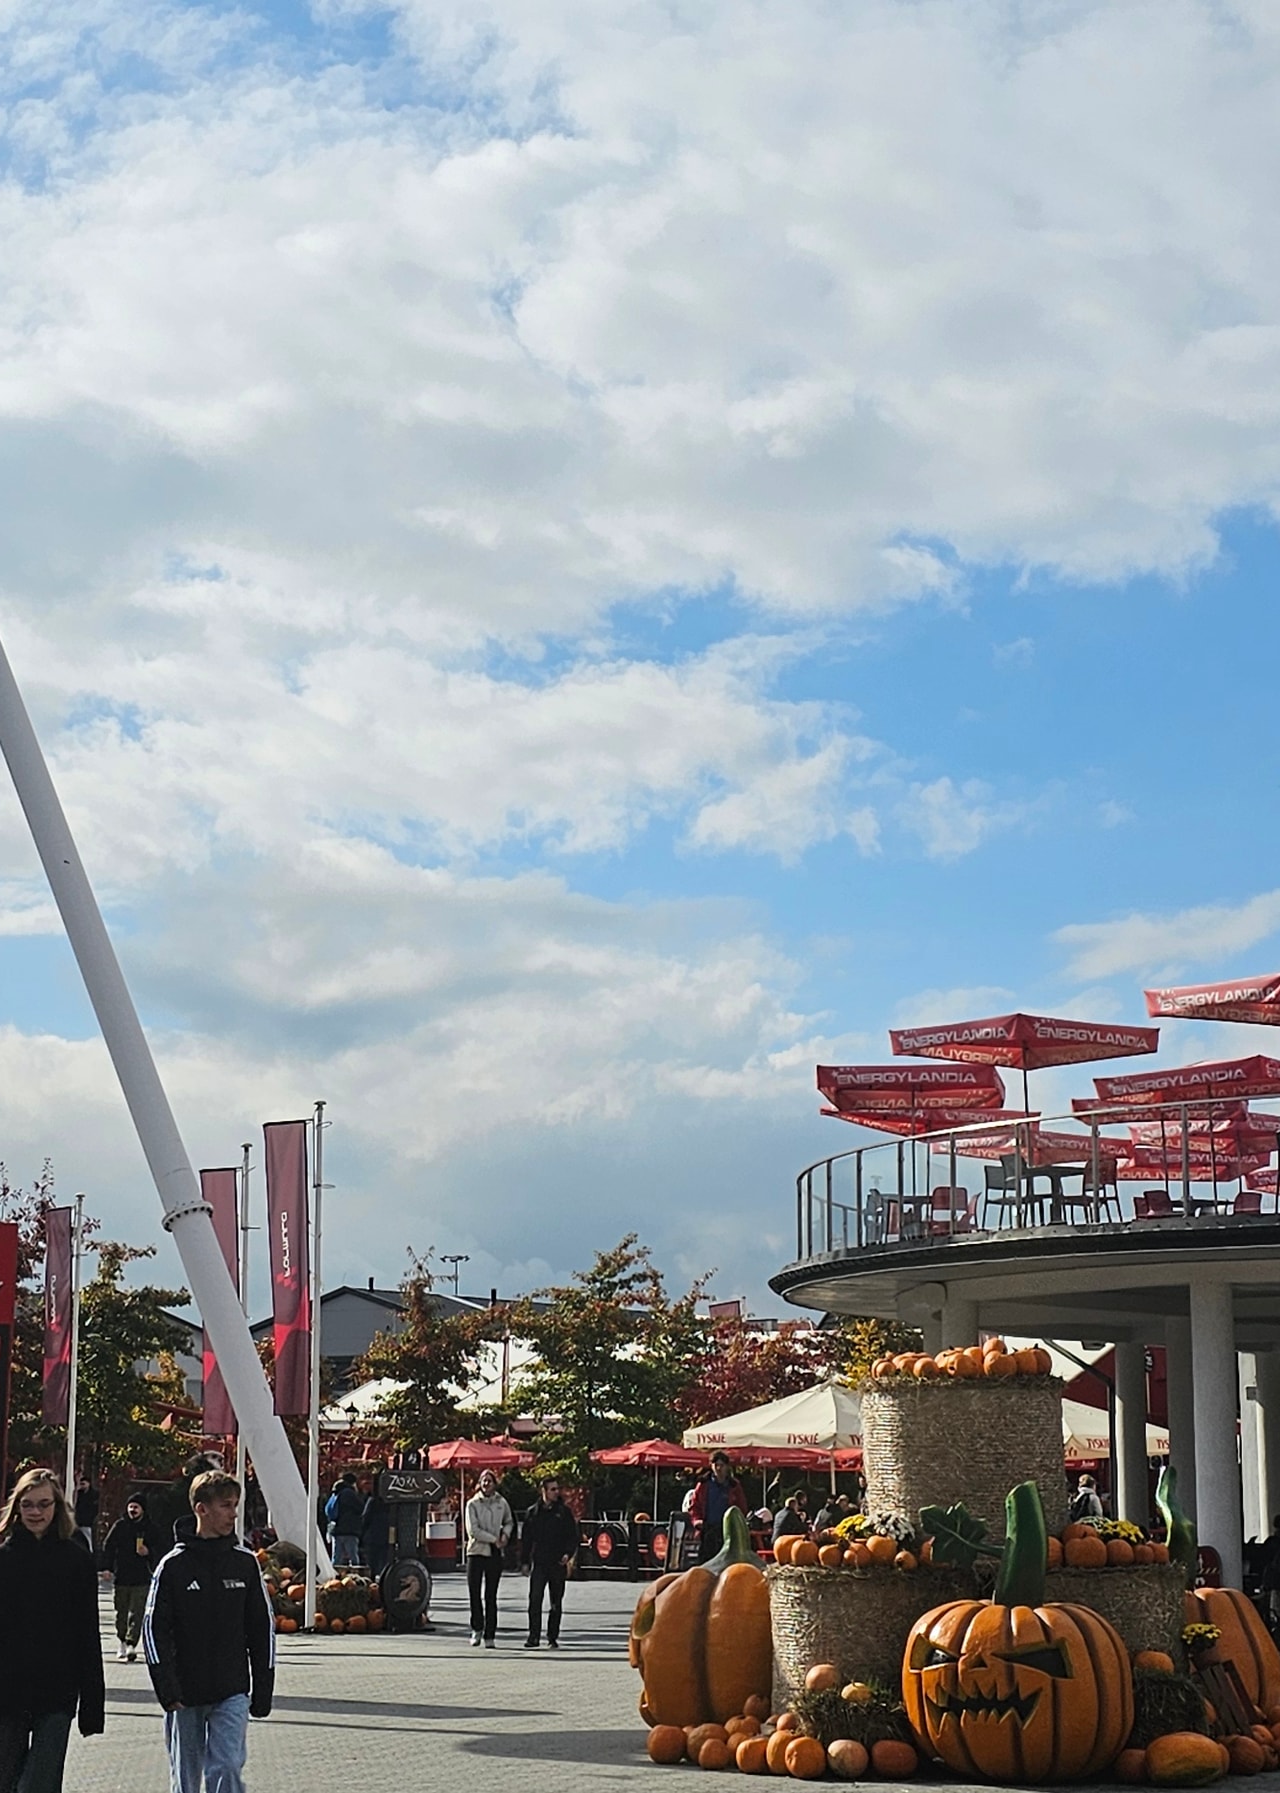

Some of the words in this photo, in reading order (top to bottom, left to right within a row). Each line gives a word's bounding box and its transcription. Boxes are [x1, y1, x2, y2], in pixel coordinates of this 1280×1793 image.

[902, 1027, 1009, 1050] ENERGYLANDIA
[1037, 1028, 1149, 1049] ENERGYLANDIA
[837, 1072, 976, 1085] ENERGYLANDIA
[1112, 1069, 1247, 1094] ENERGYLANDIA
[1037, 1137, 1127, 1155] ENERGYLNDIA
[1156, 1438, 1169, 1450] TYS
